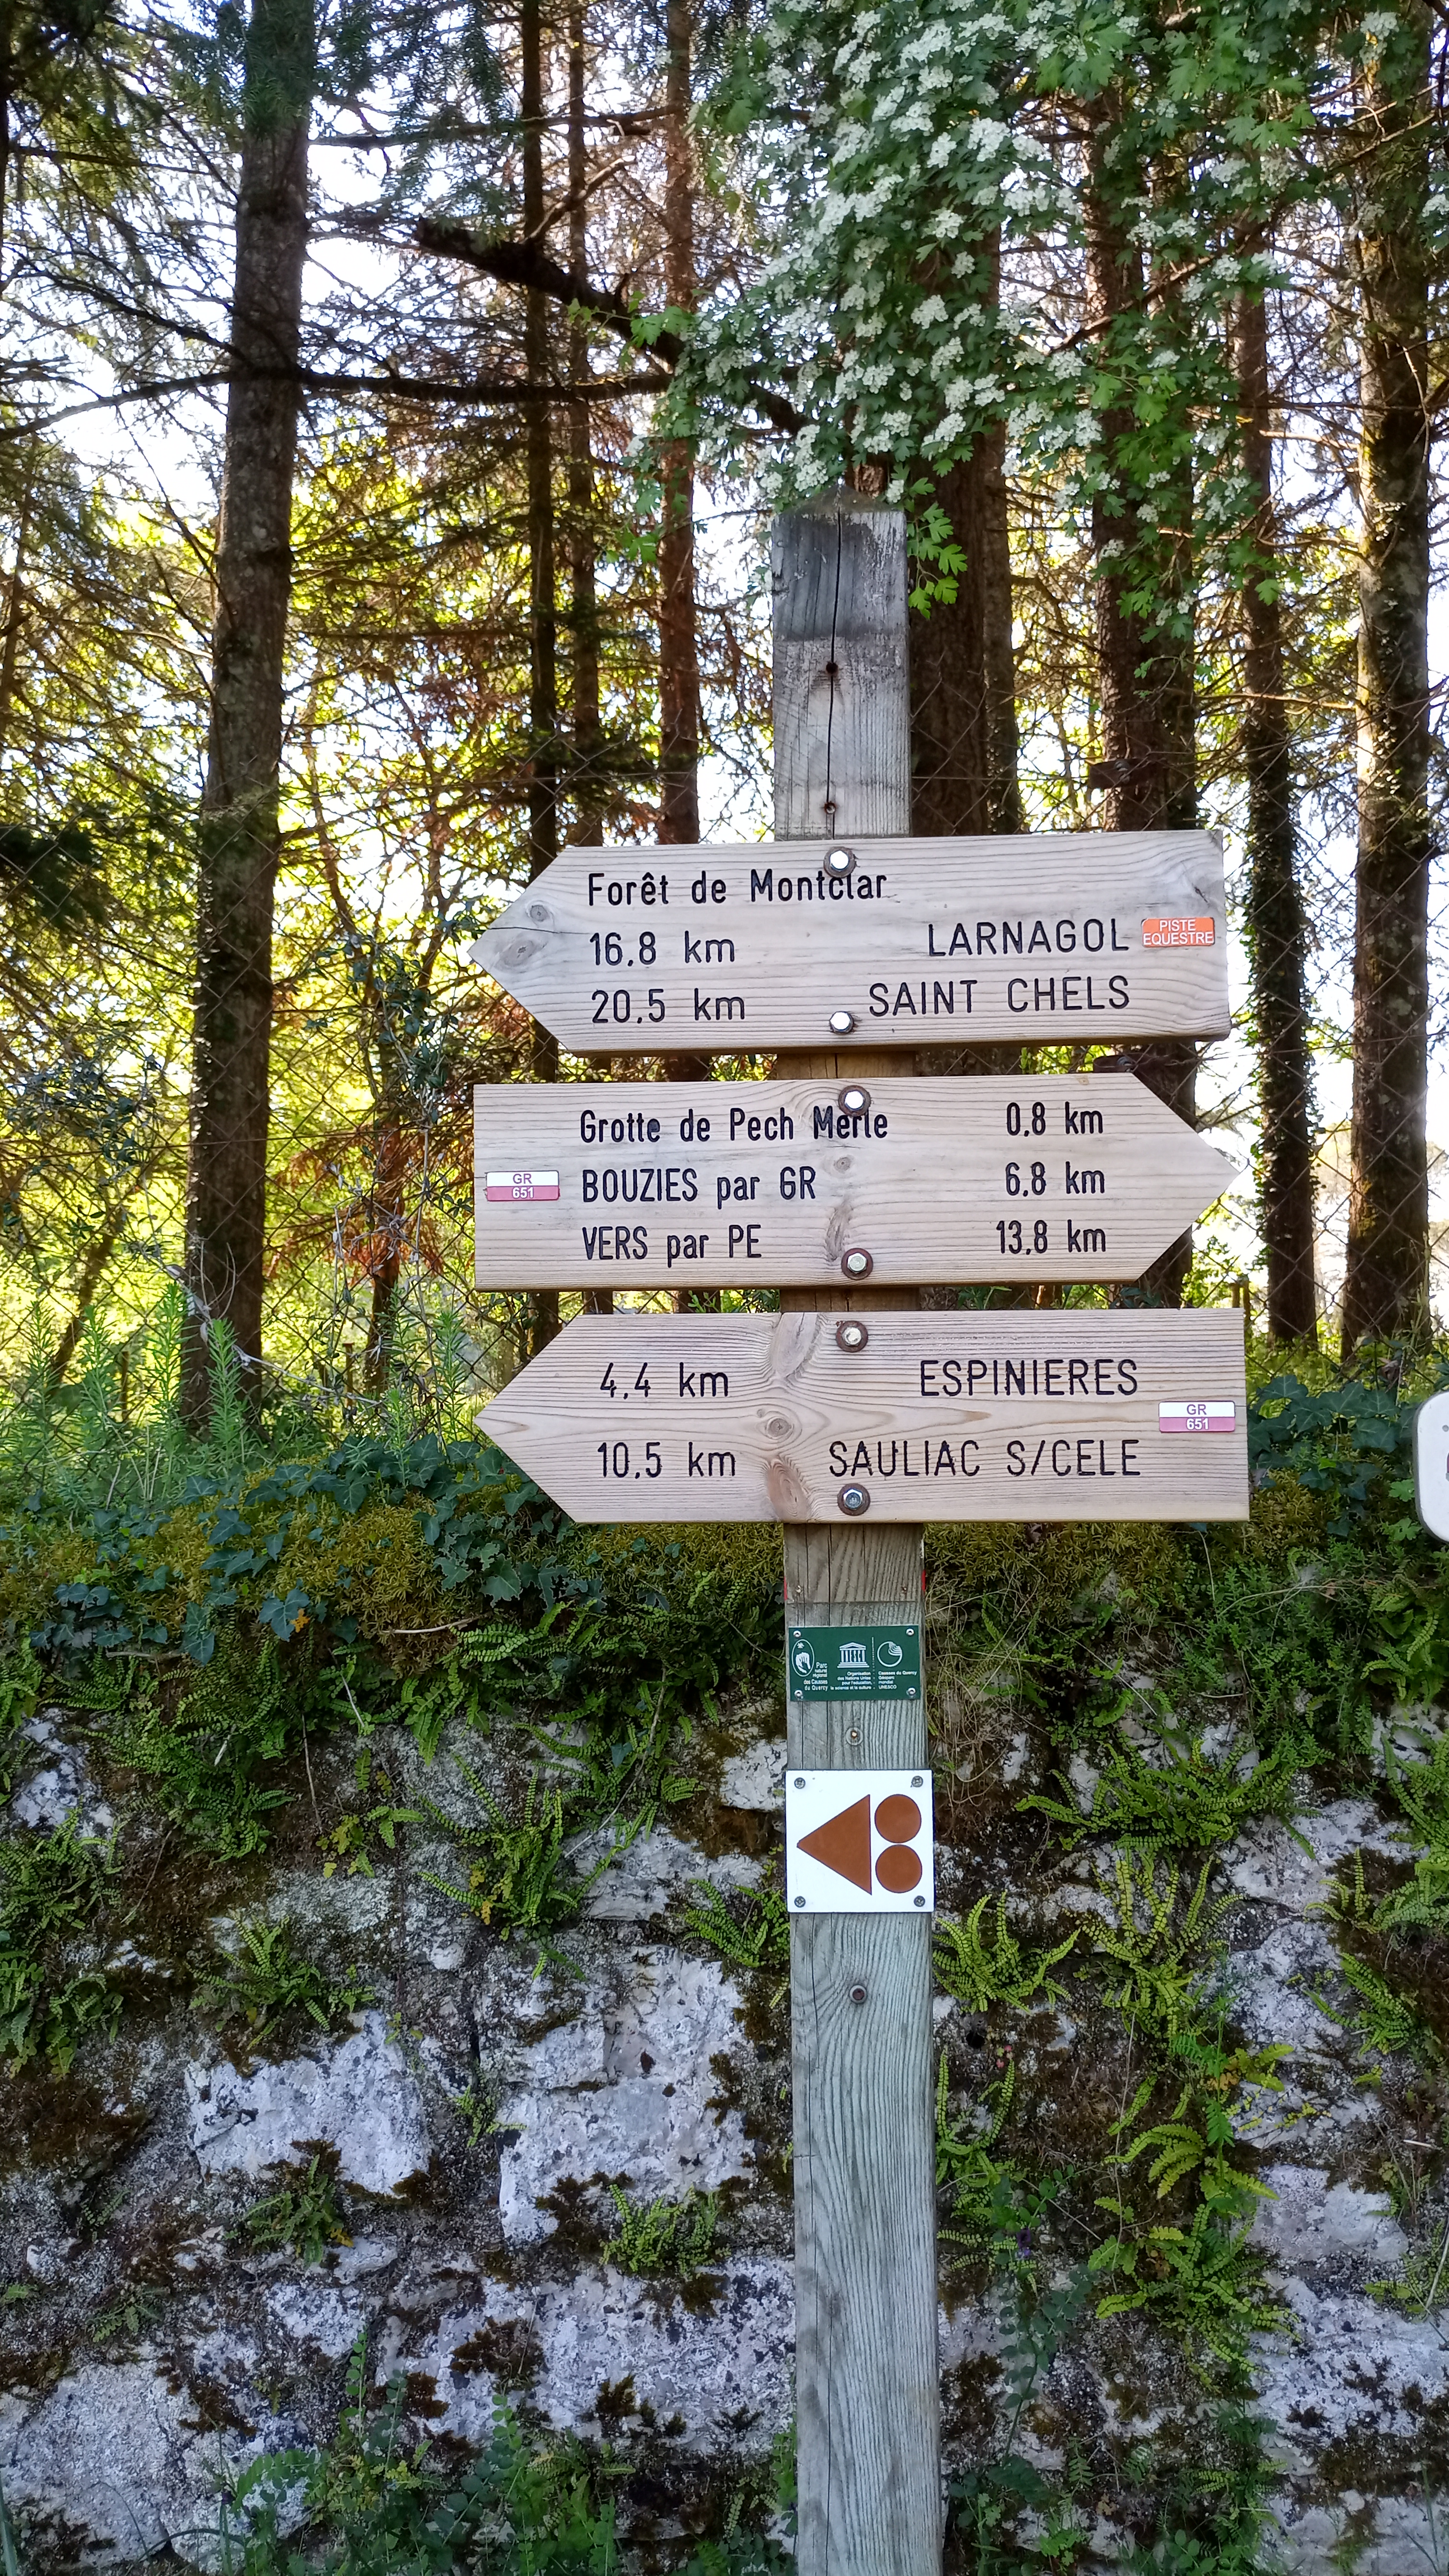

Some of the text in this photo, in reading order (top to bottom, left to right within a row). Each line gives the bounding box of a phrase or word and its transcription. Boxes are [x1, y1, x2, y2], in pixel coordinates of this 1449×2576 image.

[589, 868, 886, 906] Forêt de Montclar
[685, 931, 734, 963] km
[929, 919, 1129, 956] LARNAGOL
[1143, 932, 1214, 945] EQUESTRE
[1160, 920, 1196, 931] PISTE
[694, 988, 744, 1020] km
[870, 980, 978, 1016] SAINT
[1008, 976, 1129, 1012] CHELS
[581, 1110, 660, 1143] Grotte
[680, 1109, 710, 1141] de
[730, 1107, 793, 1140] Pech
[814, 1105, 887, 1139] Merle
[1065, 1102, 1103, 1134] km
[512, 1187, 534, 1198] 651
[513, 1173, 532, 1184] GR
[583, 1169, 698, 1203] BOUZIES
[717, 1177, 759, 1210] par
[780, 1166, 815, 1199] GR
[1066, 1162, 1104, 1194] km
[582, 1226, 647, 1260] VERS
[667, 1235, 709, 1268] par
[729, 1225, 761, 1258] PE
[1068, 1219, 1105, 1252] km
[679, 1362, 728, 1397] km
[921, 1359, 1137, 1396] ESPINIERES
[1186, 1404, 1207, 1415] GR
[1186, 1418, 1208, 1430] 651
[689, 1442, 736, 1476] km
[829, 1440, 979, 1477] SAULIAC
[1007, 1440, 1140, 1476] S/CELE
